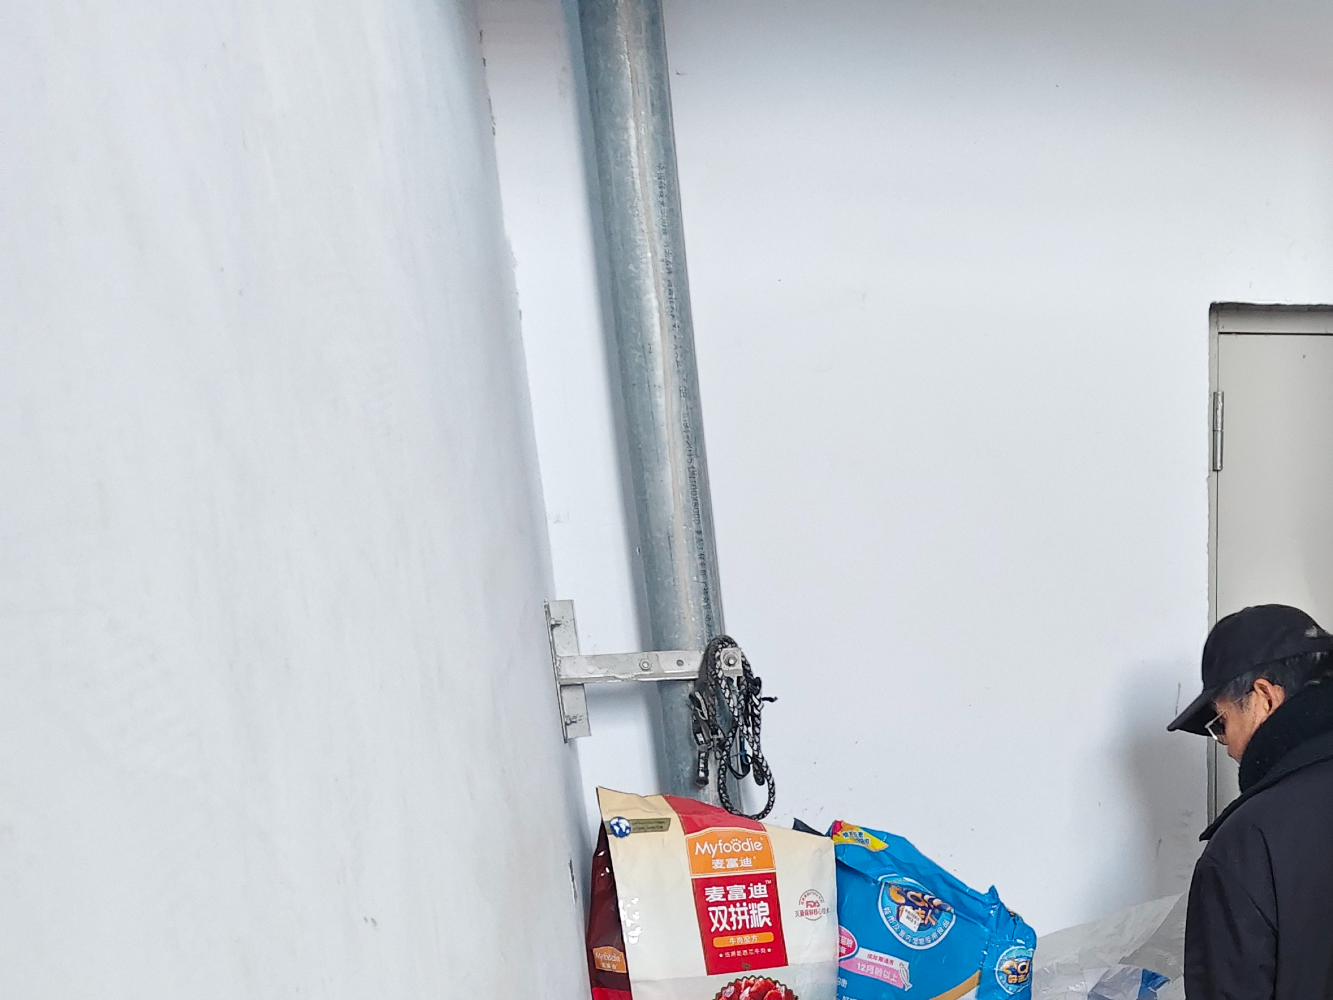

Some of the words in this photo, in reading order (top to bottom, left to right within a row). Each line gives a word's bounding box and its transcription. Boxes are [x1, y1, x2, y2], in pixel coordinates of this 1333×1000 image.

[694, 838, 763, 858] Myfoodie
[712, 857, 753, 870] 麦富迪
[704, 882, 769, 903] 麦富迪
[707, 900, 773, 933] 双拼粮
[857, 962, 898, 983] 12月龄以上
